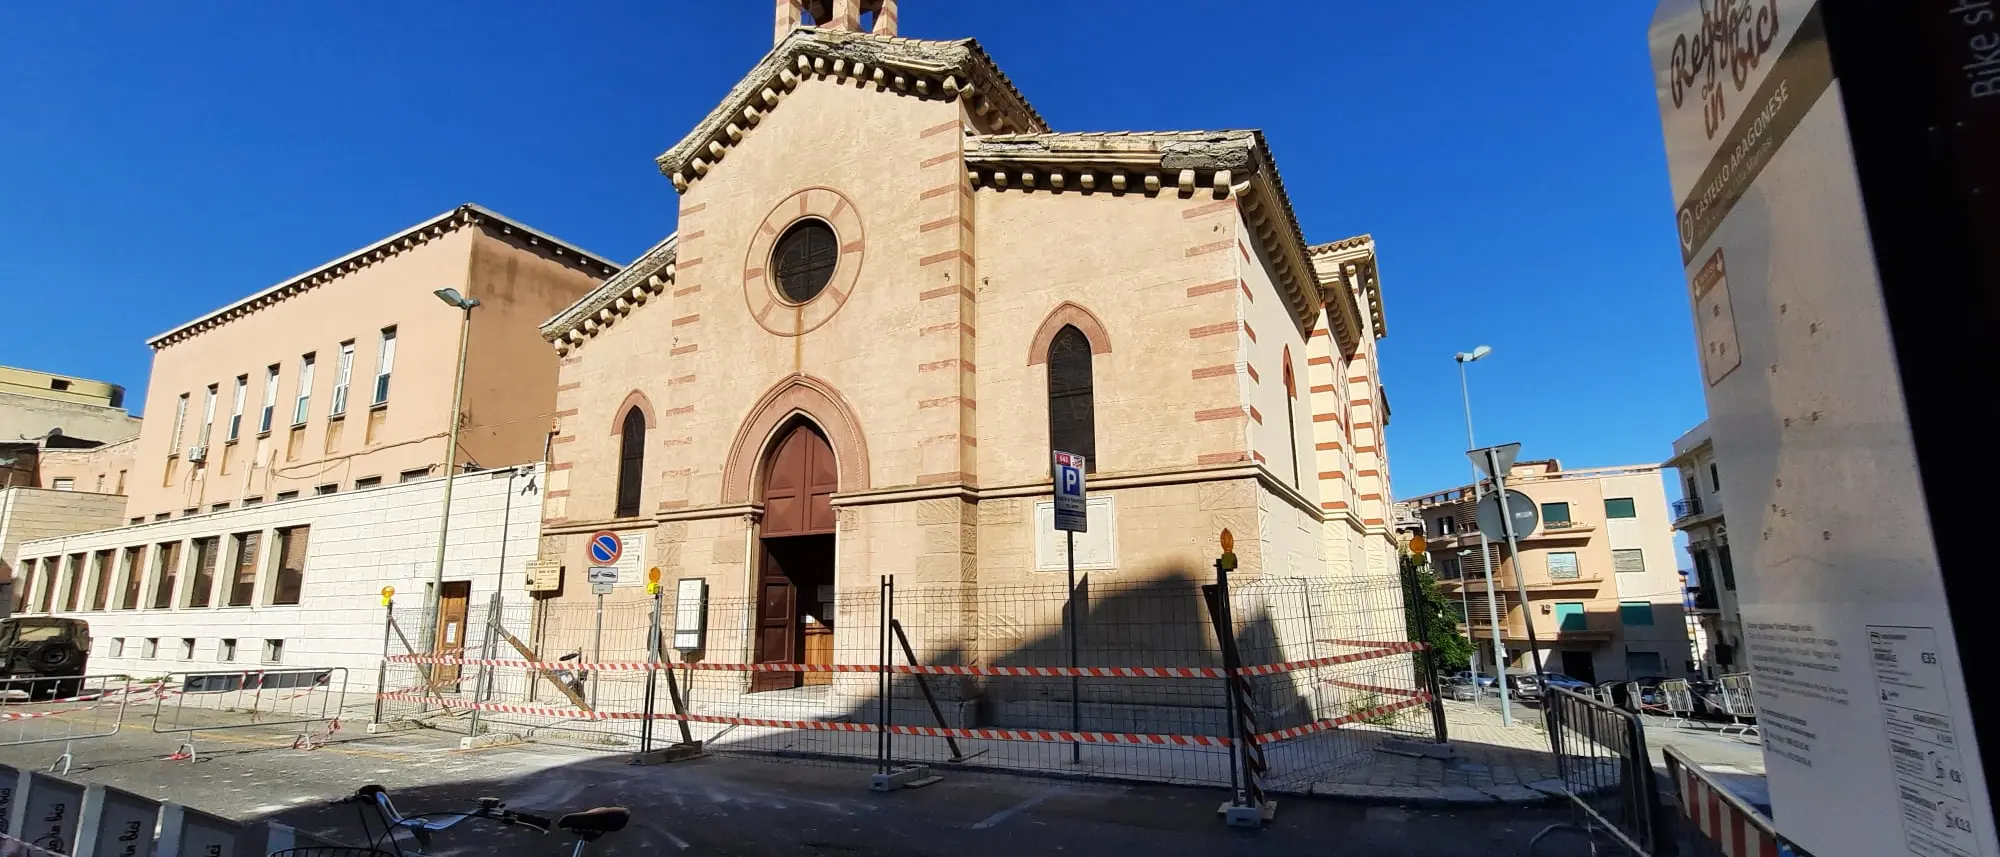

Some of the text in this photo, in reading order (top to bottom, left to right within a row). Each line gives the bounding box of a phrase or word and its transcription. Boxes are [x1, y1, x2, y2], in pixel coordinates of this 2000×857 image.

[1961, 32, 2000, 98] Bike
[1701, 82, 1725, 141] in
[1694, 164, 1730, 221] CASTELLO
[1730, 78, 1790, 173] ARAGONESE
[1066, 469, 1076, 492] P
